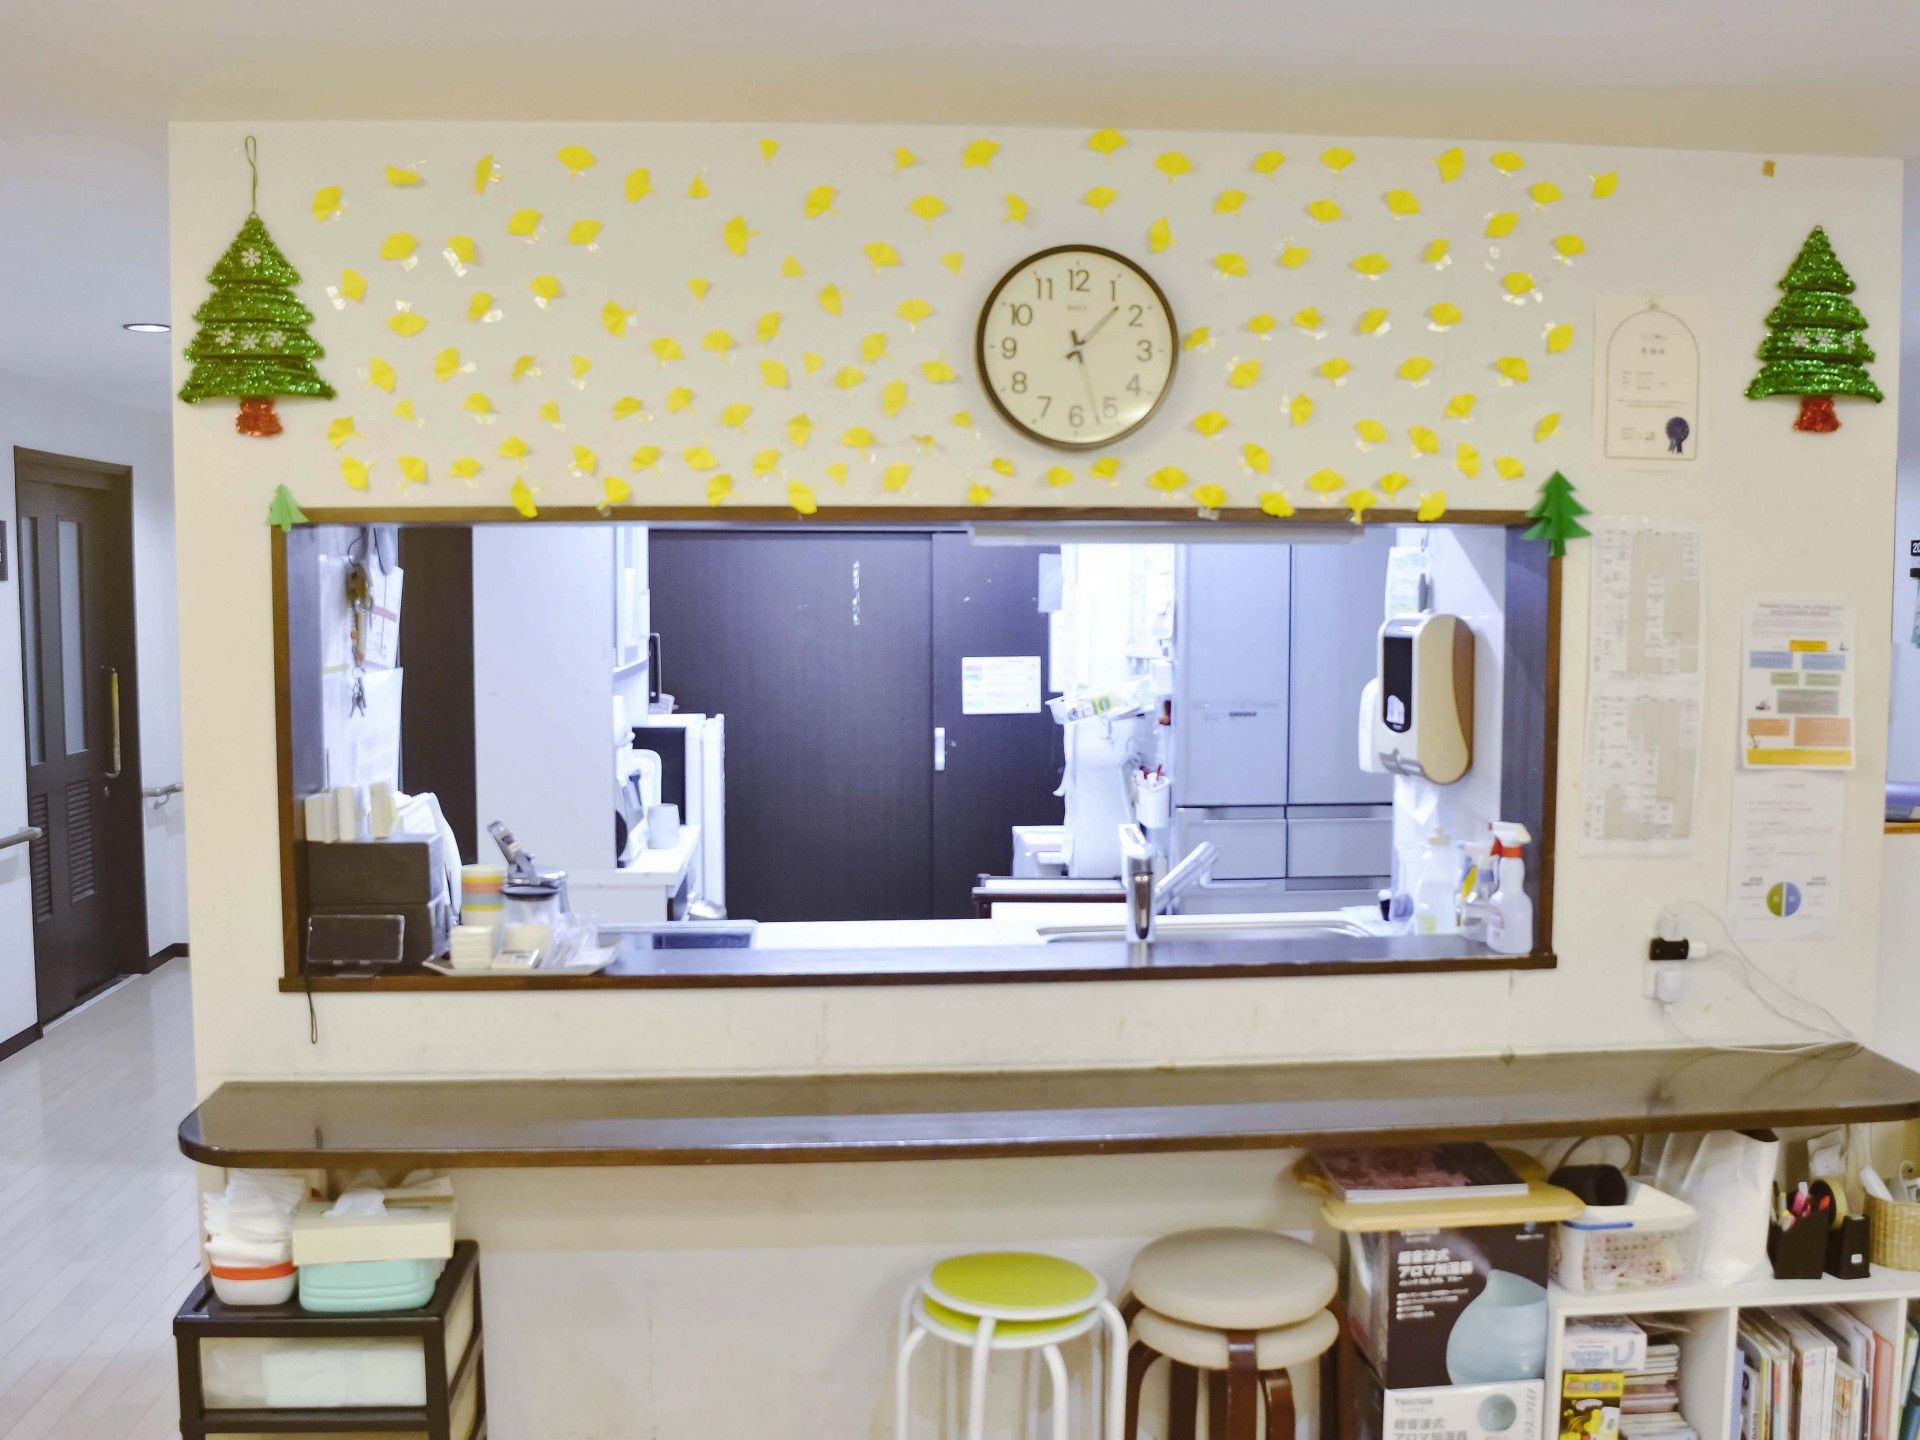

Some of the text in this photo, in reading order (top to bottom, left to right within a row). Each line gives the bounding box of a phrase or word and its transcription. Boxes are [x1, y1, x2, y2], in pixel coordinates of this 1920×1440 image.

[1035, 278, 1053, 300] 11
[1068, 269, 1090, 292] 12
[1110, 280, 1116, 302] 1
[1010, 303, 1033, 326] 10
[1128, 304, 1143, 327] 2
[1002, 336, 1017, 360] 9
[1137, 340, 1152, 362] 3
[1011, 371, 1027, 394] 8
[1126, 374, 1142, 395] 4
[1038, 396, 1052, 418] 7
[1069, 405, 1084, 428] 6
[1103, 397, 1118, 419] 5
